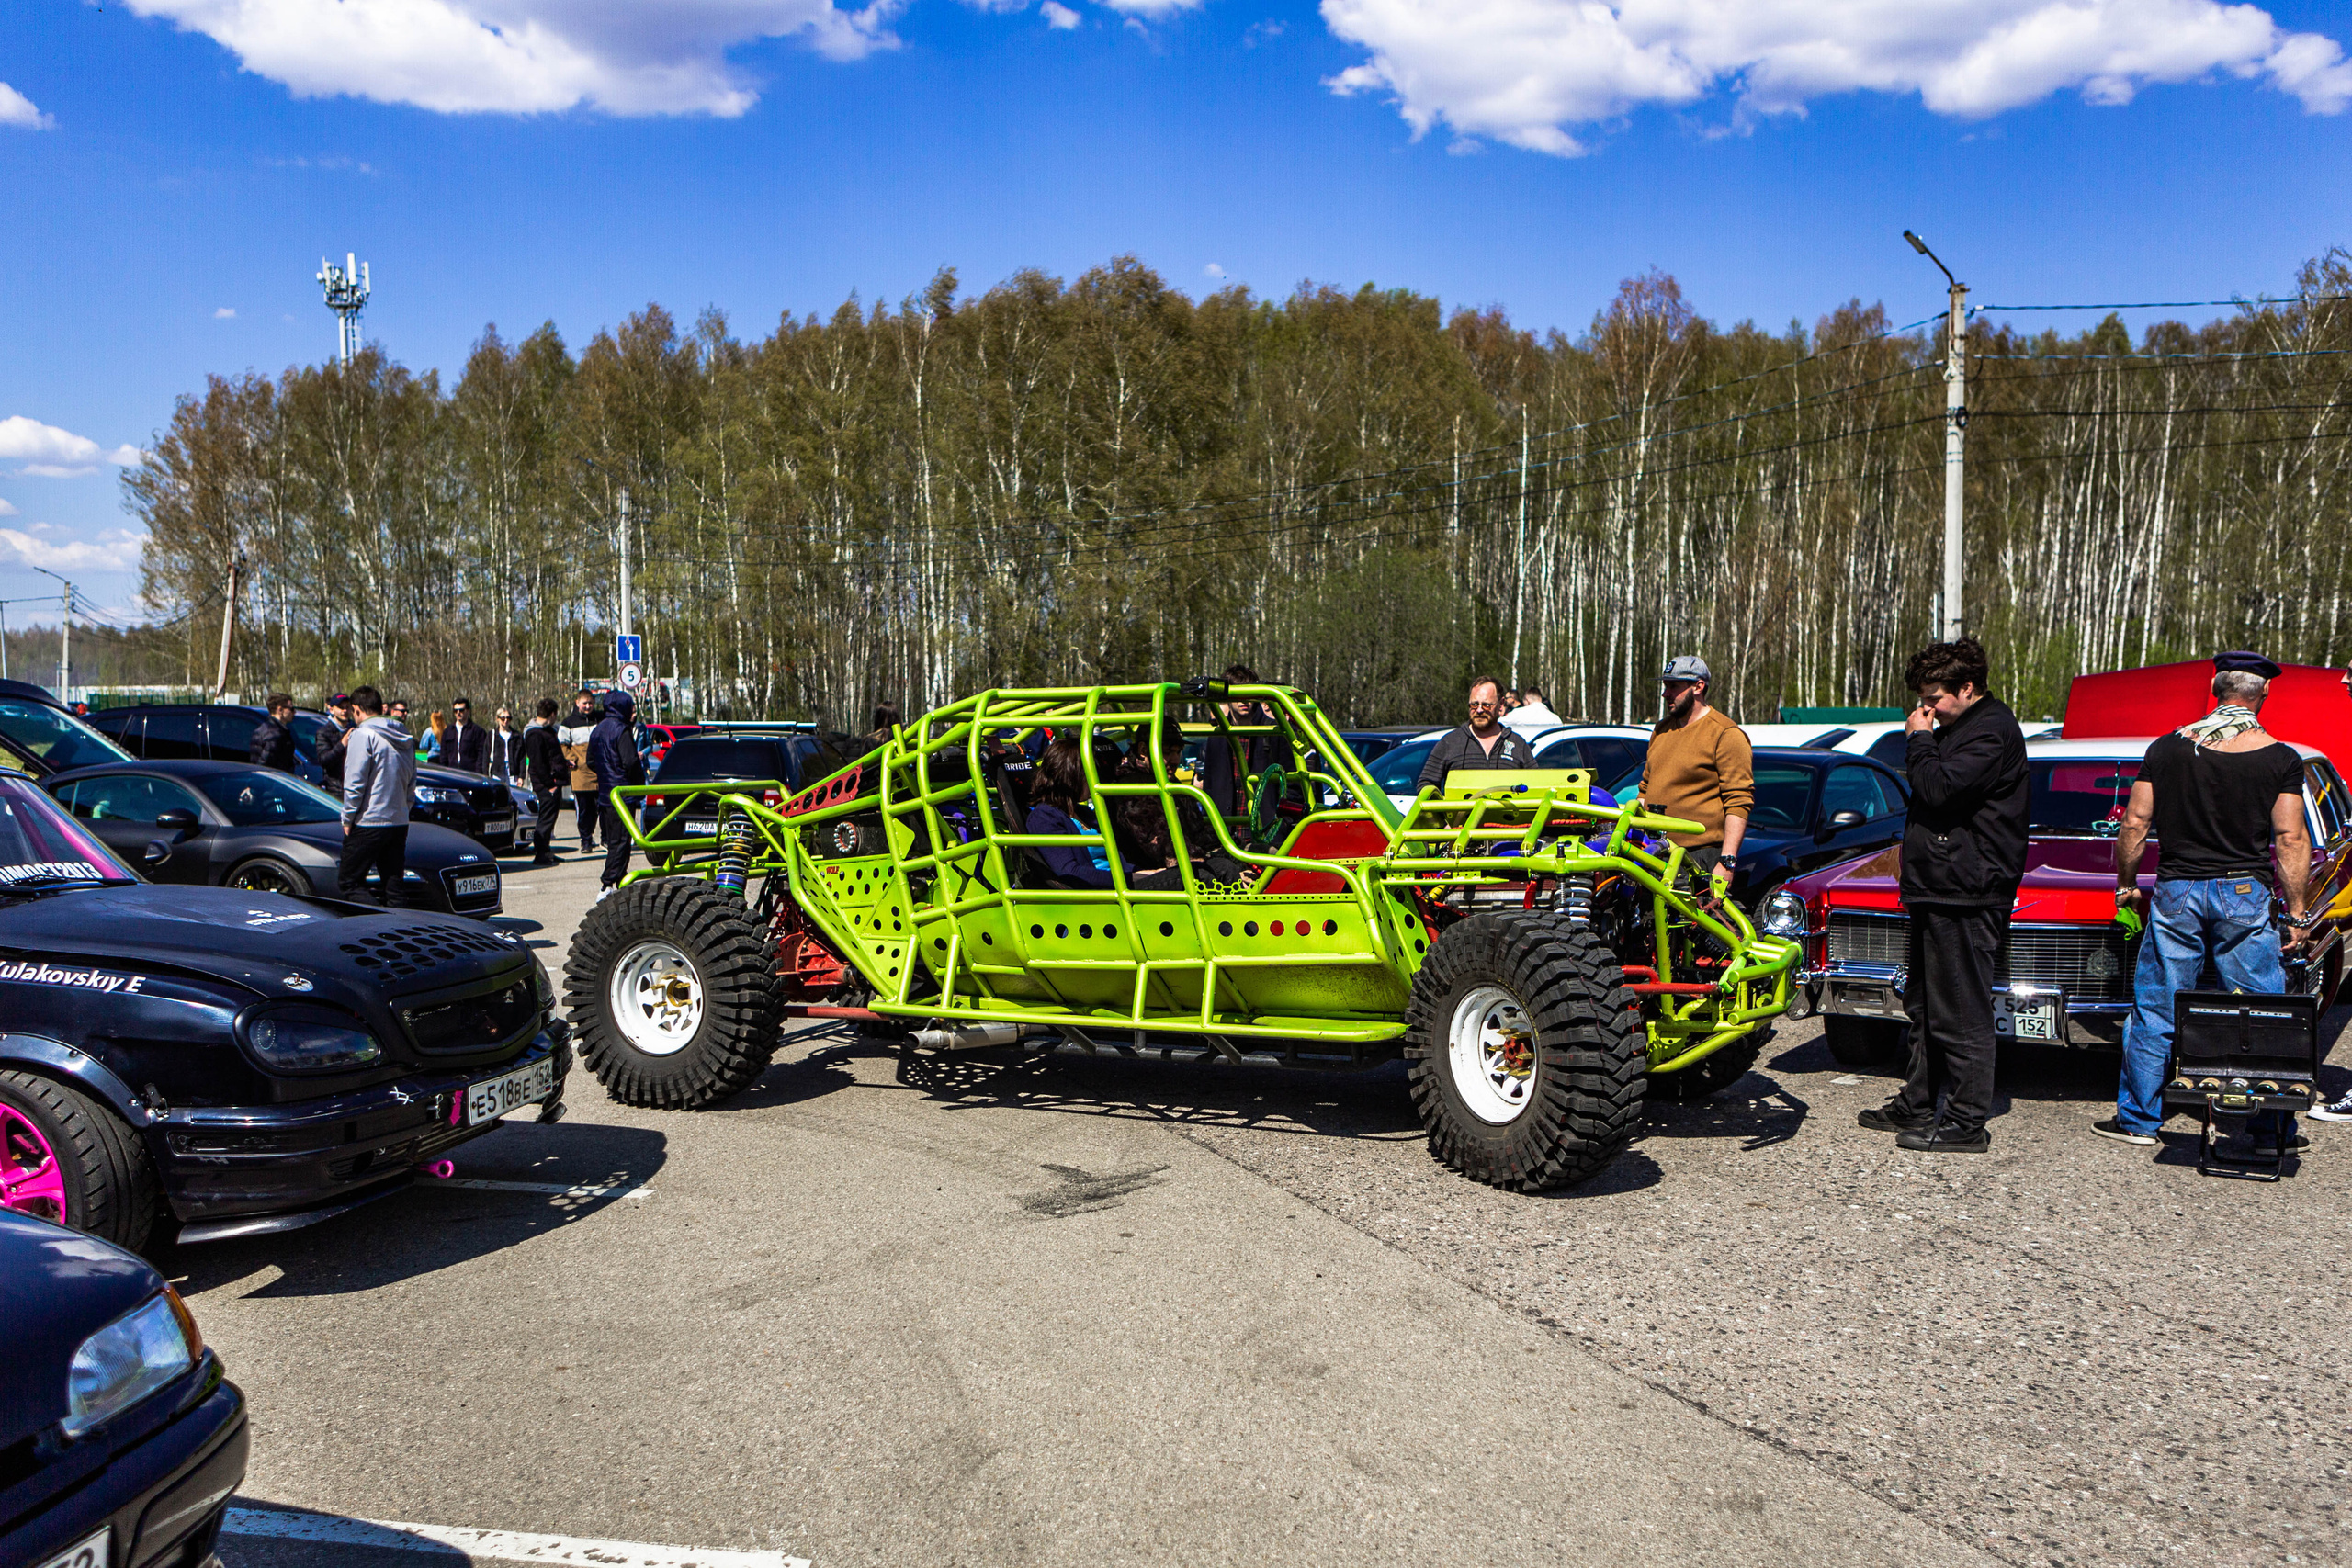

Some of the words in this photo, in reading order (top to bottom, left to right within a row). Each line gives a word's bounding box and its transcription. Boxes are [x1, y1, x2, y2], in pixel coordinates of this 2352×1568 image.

[628, 671, 635, 682] 5
[1004, 761, 1032, 771] BRIDE
[688, 821, 716, 830] Н620А
[125, 976, 146, 992] E
[2005, 998, 2039, 1015] 525
[2018, 1018, 2045, 1032] 152
[534, 1063, 551, 1087] 152
